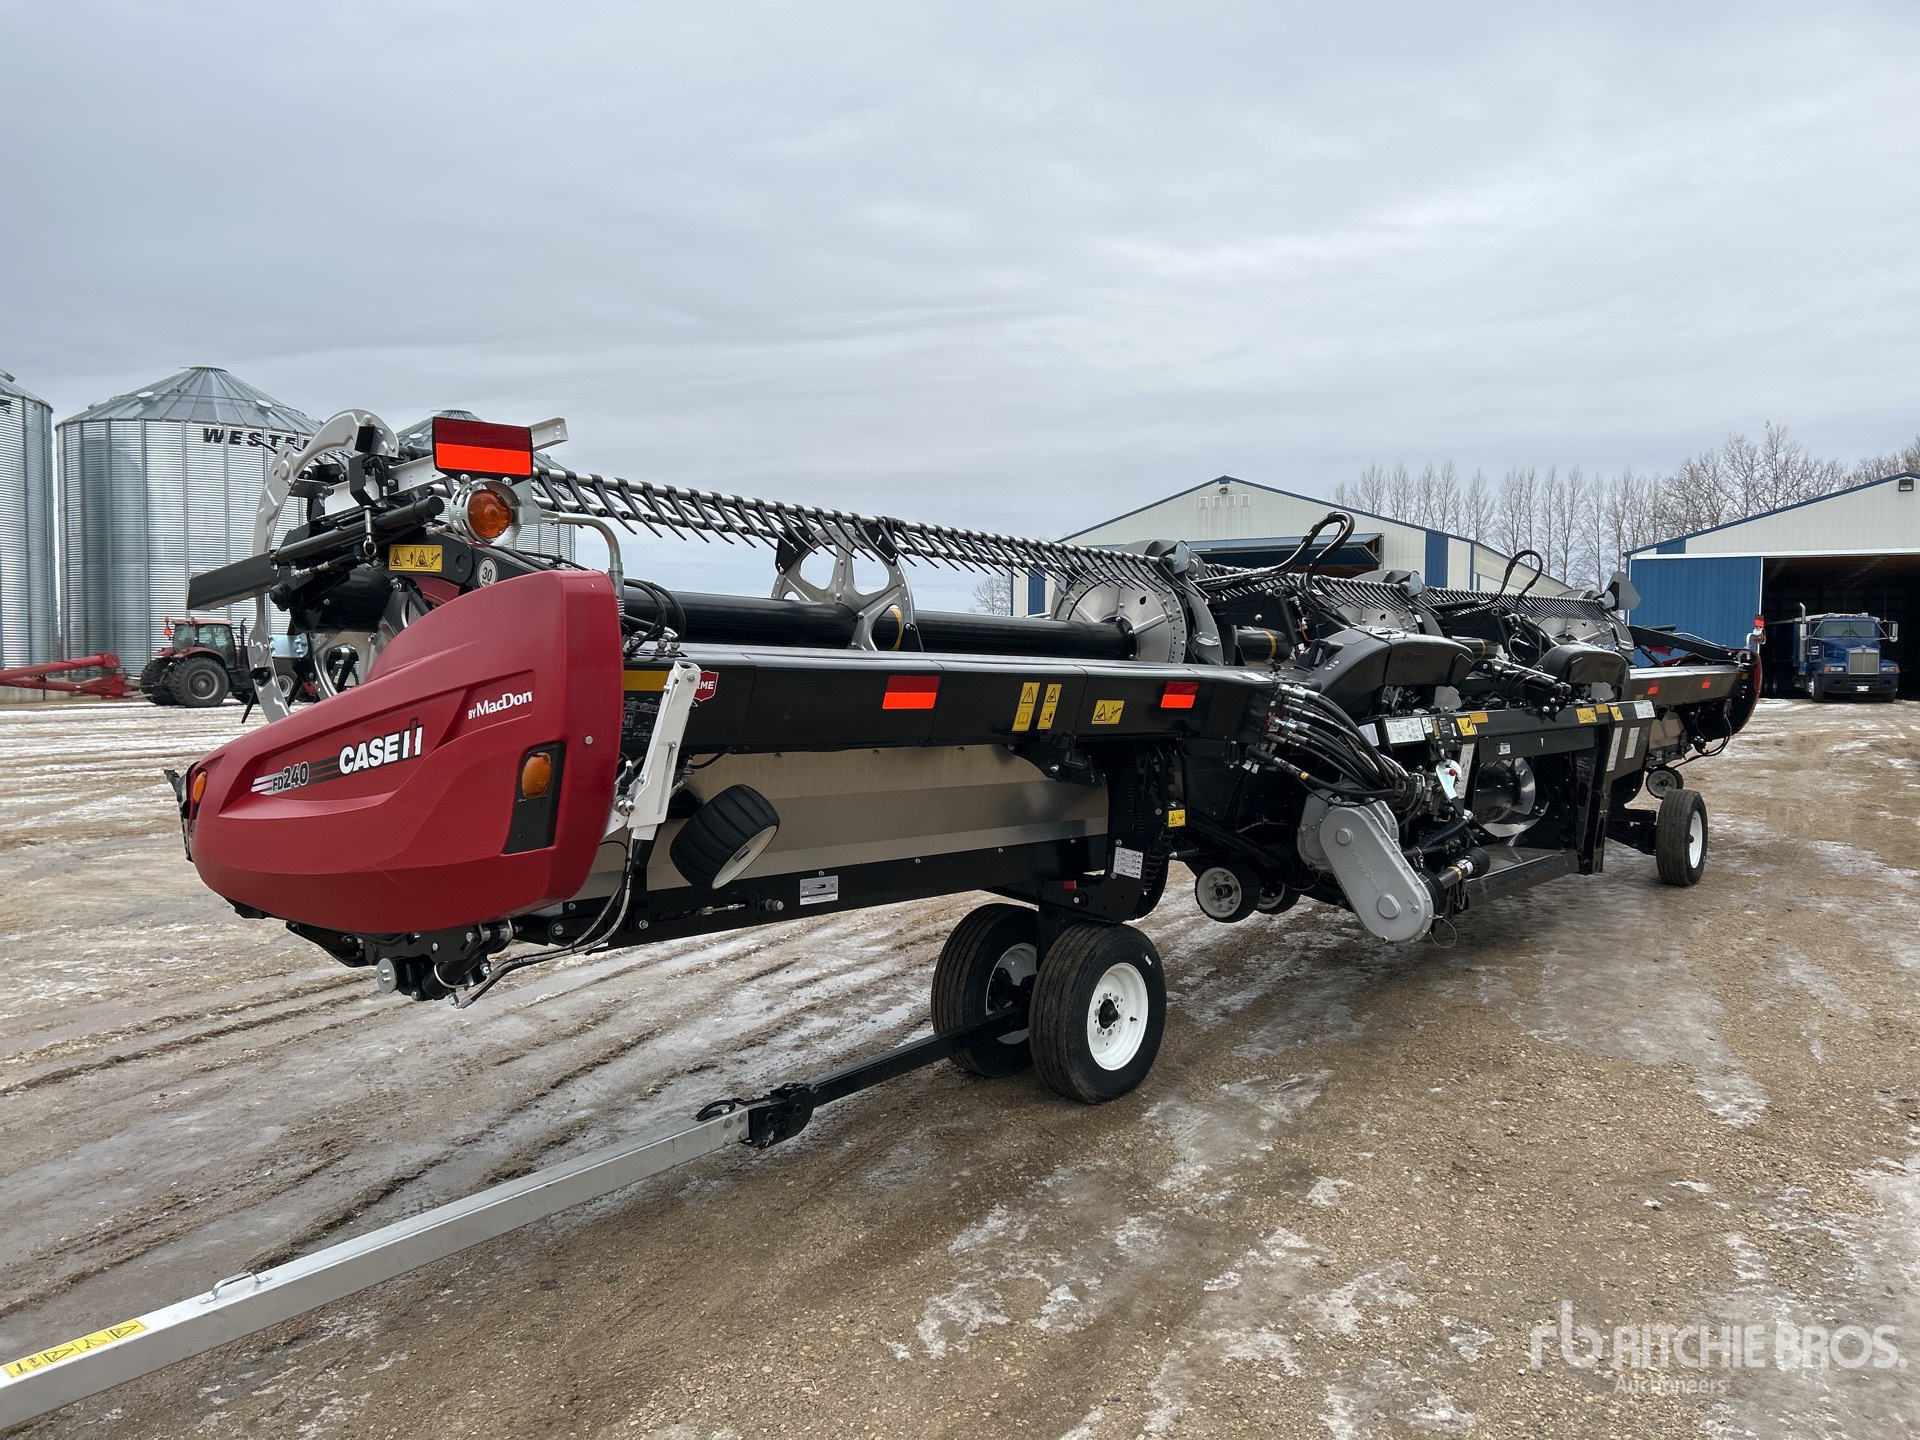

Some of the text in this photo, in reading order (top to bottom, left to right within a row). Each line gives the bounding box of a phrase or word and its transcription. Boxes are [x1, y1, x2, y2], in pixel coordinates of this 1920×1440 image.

[482, 567, 493, 582] 30
[468, 691, 533, 720] BY MacDon
[339, 733, 400, 775] CASE
[272, 762, 309, 792] FD240
